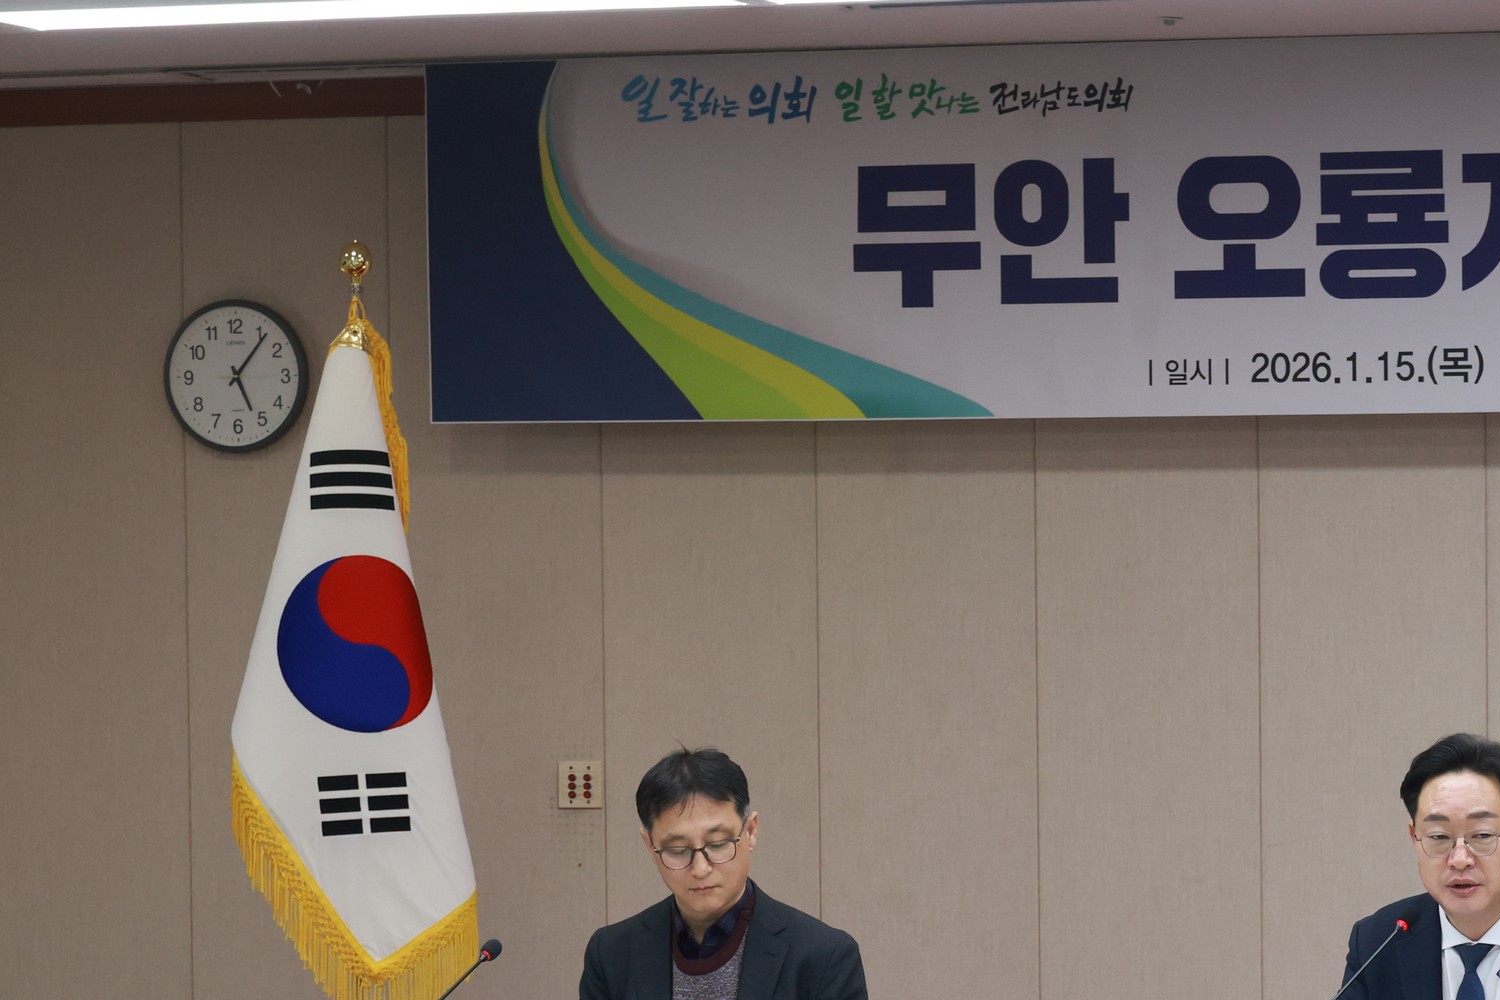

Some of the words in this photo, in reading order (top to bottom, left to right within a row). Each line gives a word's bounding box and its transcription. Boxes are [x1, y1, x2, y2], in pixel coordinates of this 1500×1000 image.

[748, 75, 818, 125] 의회
[989, 77, 1134, 118] 전라남도의회
[853, 158, 1130, 308] 무안
[205, 326, 217, 341] 11
[227, 318, 243, 334] 12
[256, 325, 263, 341] 1
[189, 344, 205, 360] 10
[272, 343, 282, 358] 2
[1251, 345, 1484, 385] 2026.1.15.(목)
[183, 370, 194, 386] 9
[280, 368, 291, 384] 3
[193, 396, 204, 412] 8
[273, 395, 283, 410] 4
[211, 413, 222, 429] 7
[233, 418, 243, 434] 6
[257, 411, 268, 427] 5
